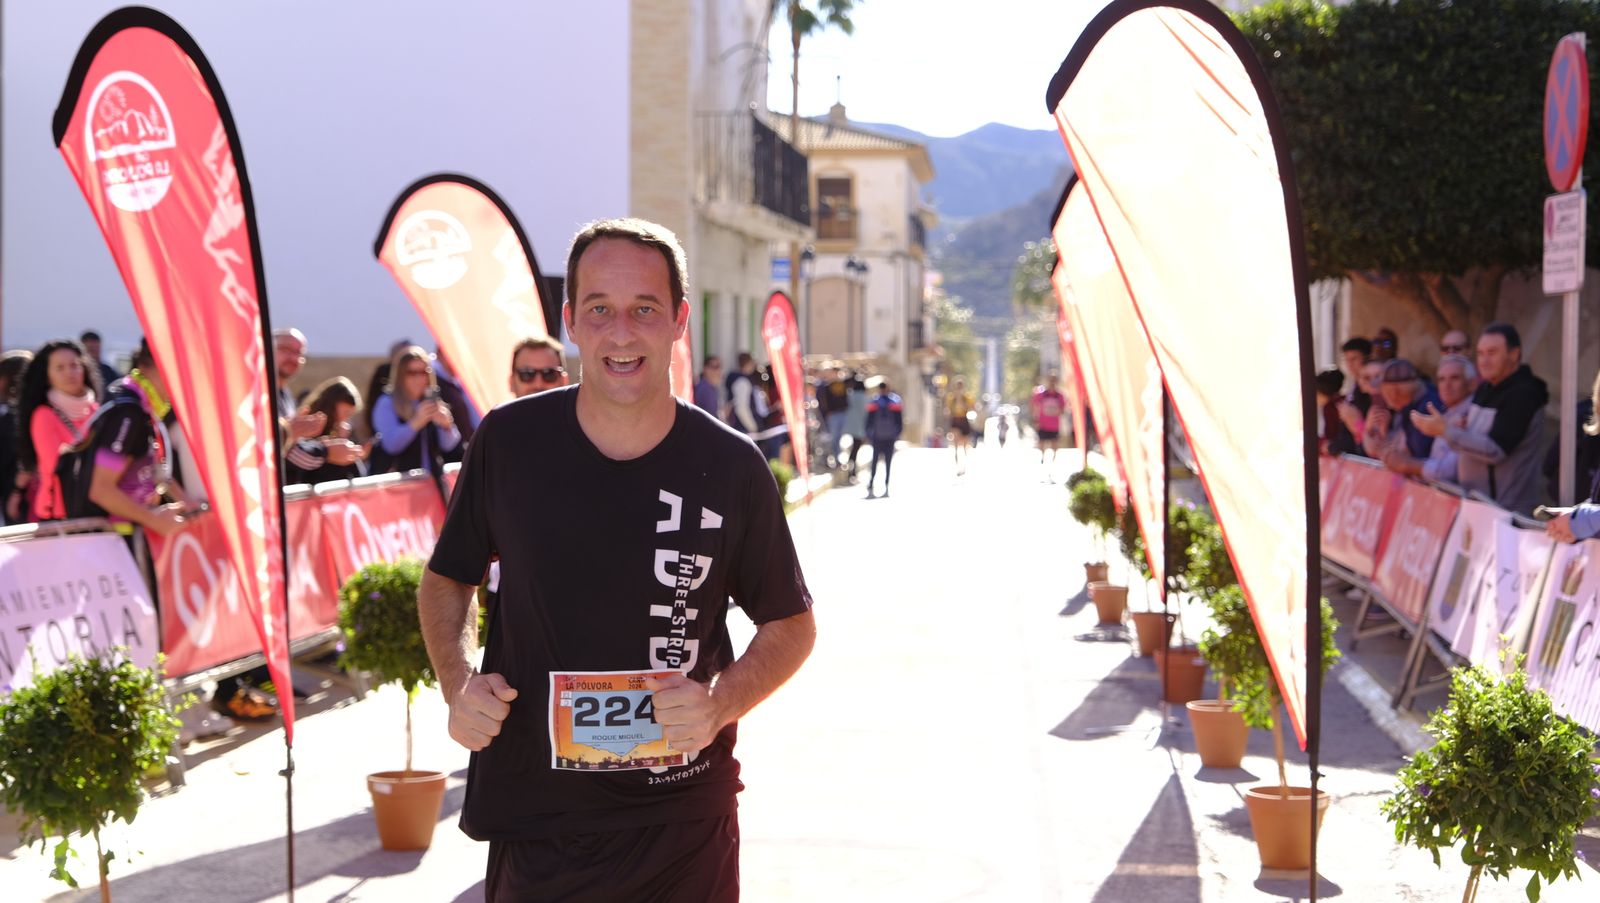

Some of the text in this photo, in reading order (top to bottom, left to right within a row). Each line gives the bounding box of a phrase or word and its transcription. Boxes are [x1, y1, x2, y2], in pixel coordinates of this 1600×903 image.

[97, 573, 129, 599] DE
[665, 553, 696, 667] THREE STRIP
[565, 681, 575, 690] LA
[574, 695, 657, 727] 224
[591, 733, 645, 741] ROQUE MIGUEL
